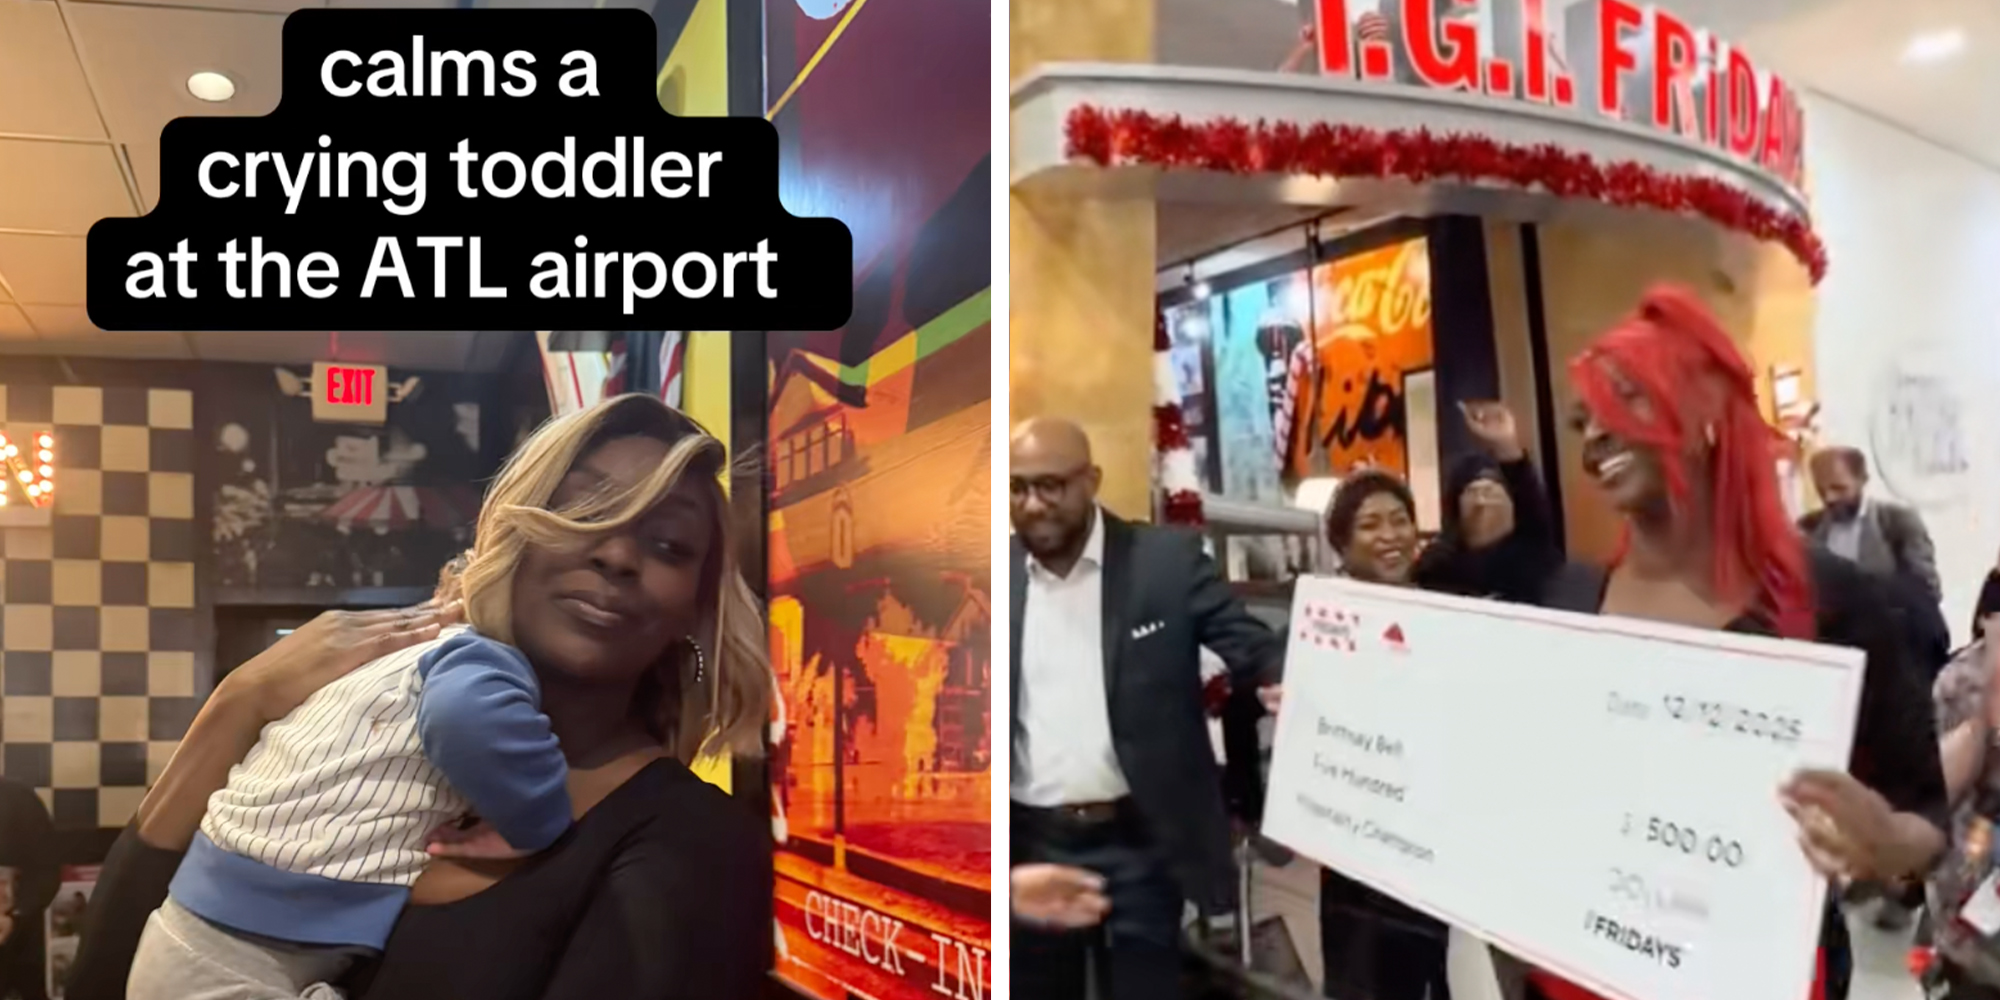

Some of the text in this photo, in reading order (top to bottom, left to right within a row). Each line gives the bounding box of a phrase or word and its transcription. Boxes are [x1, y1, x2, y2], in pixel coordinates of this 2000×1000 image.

[327, 366, 375, 406] EXIT
[804, 889, 987, 1000] CHECK-IN
[1594, 915, 1683, 969] FRIDAYS
